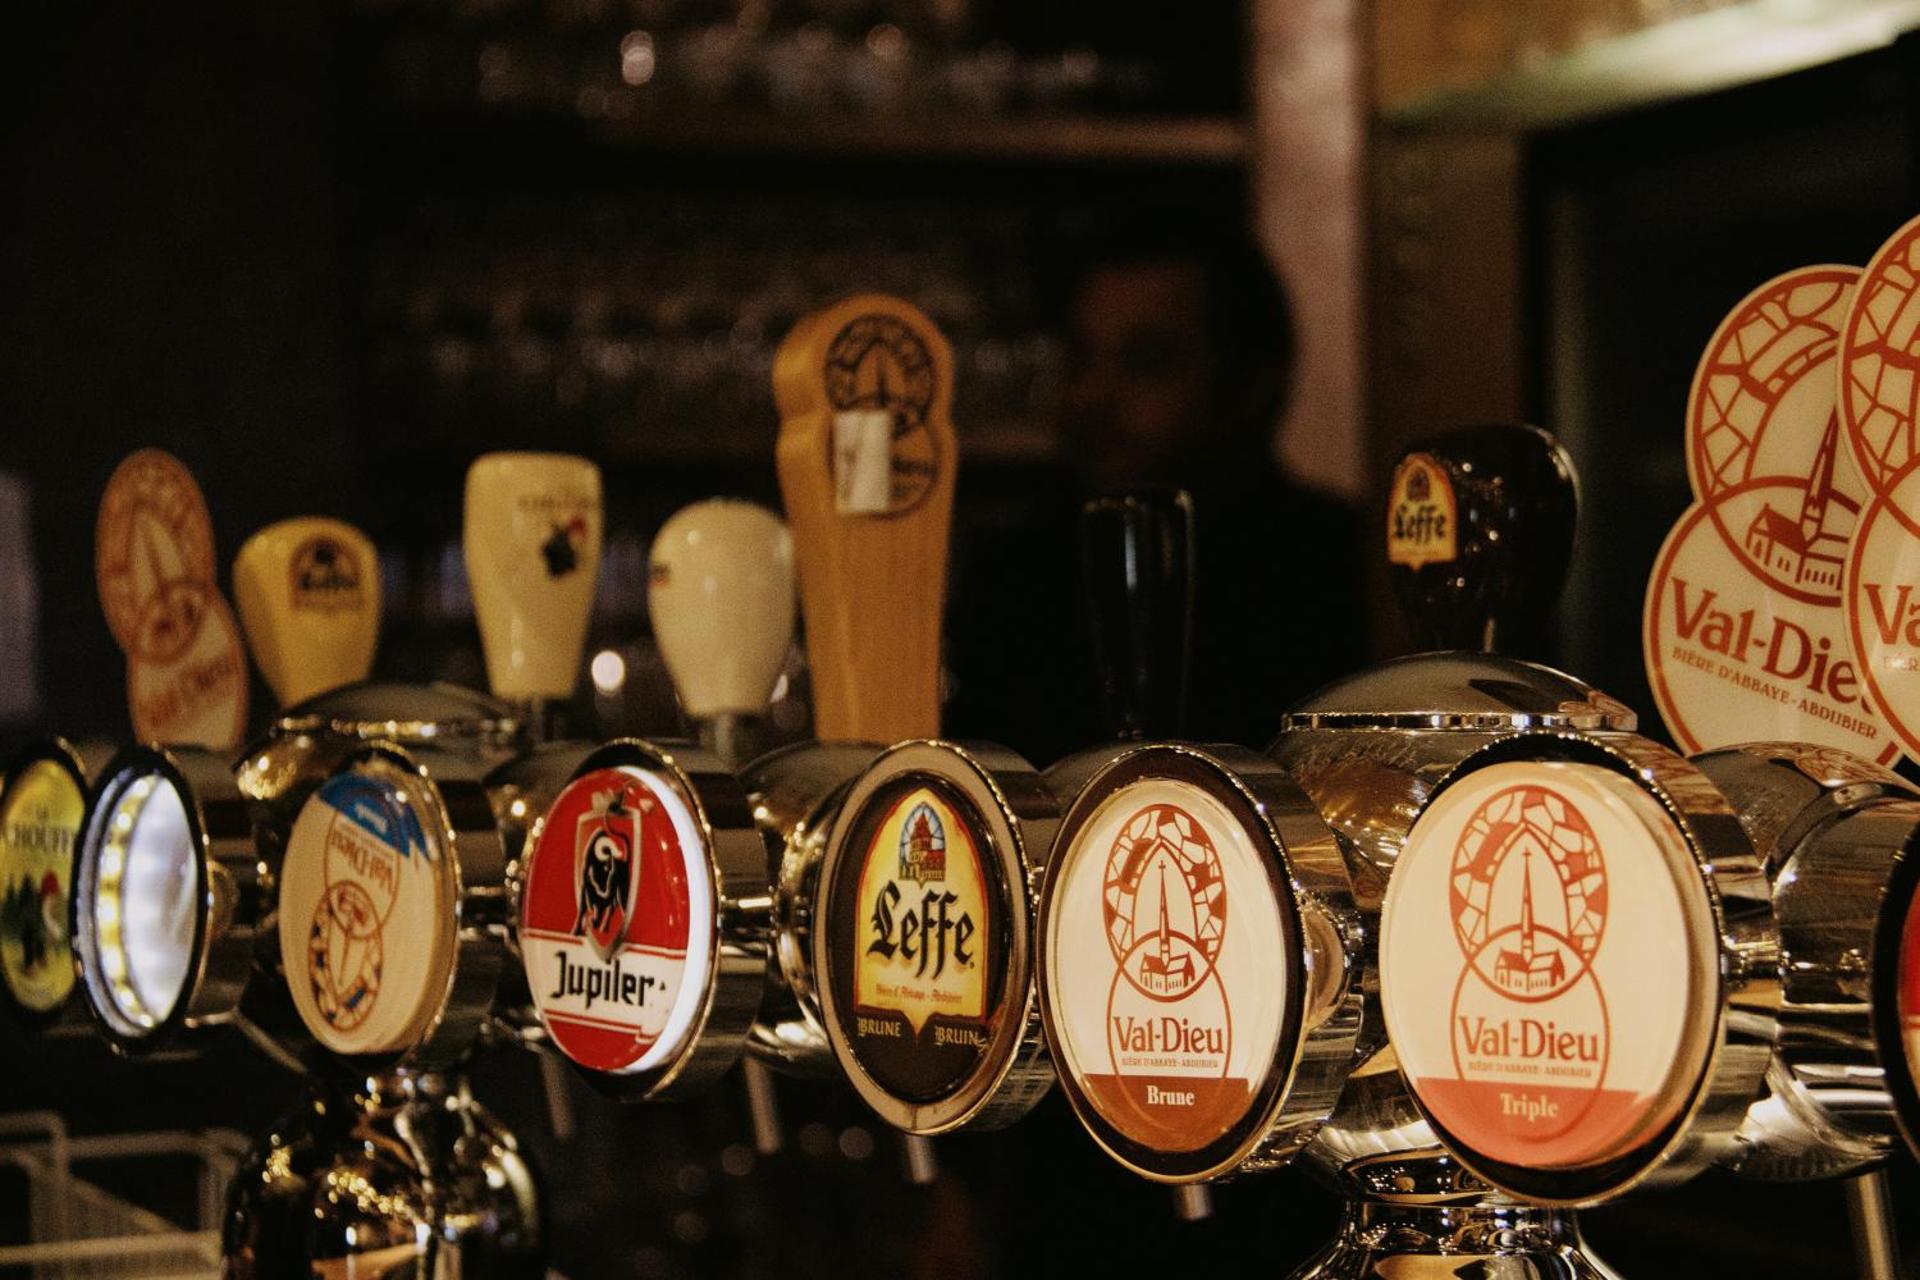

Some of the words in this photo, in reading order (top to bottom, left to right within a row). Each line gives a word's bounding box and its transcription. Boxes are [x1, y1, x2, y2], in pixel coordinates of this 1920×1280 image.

[1395, 504, 1446, 545] Leffe
[1671, 576, 1873, 716] Val-Die
[1671, 646, 1715, 674] BIÈRE
[1718, 665, 1791, 705] D'ABBAYE
[1797, 698, 1878, 740] ABDIJBIER
[867, 880, 975, 980] Leffe
[550, 951, 655, 1010] Jupiler
[857, 1017, 901, 1038] BRUNE
[934, 1025, 980, 1047] BRUIN
[1112, 1015, 1224, 1054] Val-Dieu
[1458, 1015, 1599, 1062] Val-Dieu
[1146, 1084, 1195, 1106] Brune
[1500, 1092, 1559, 1123] Triple
